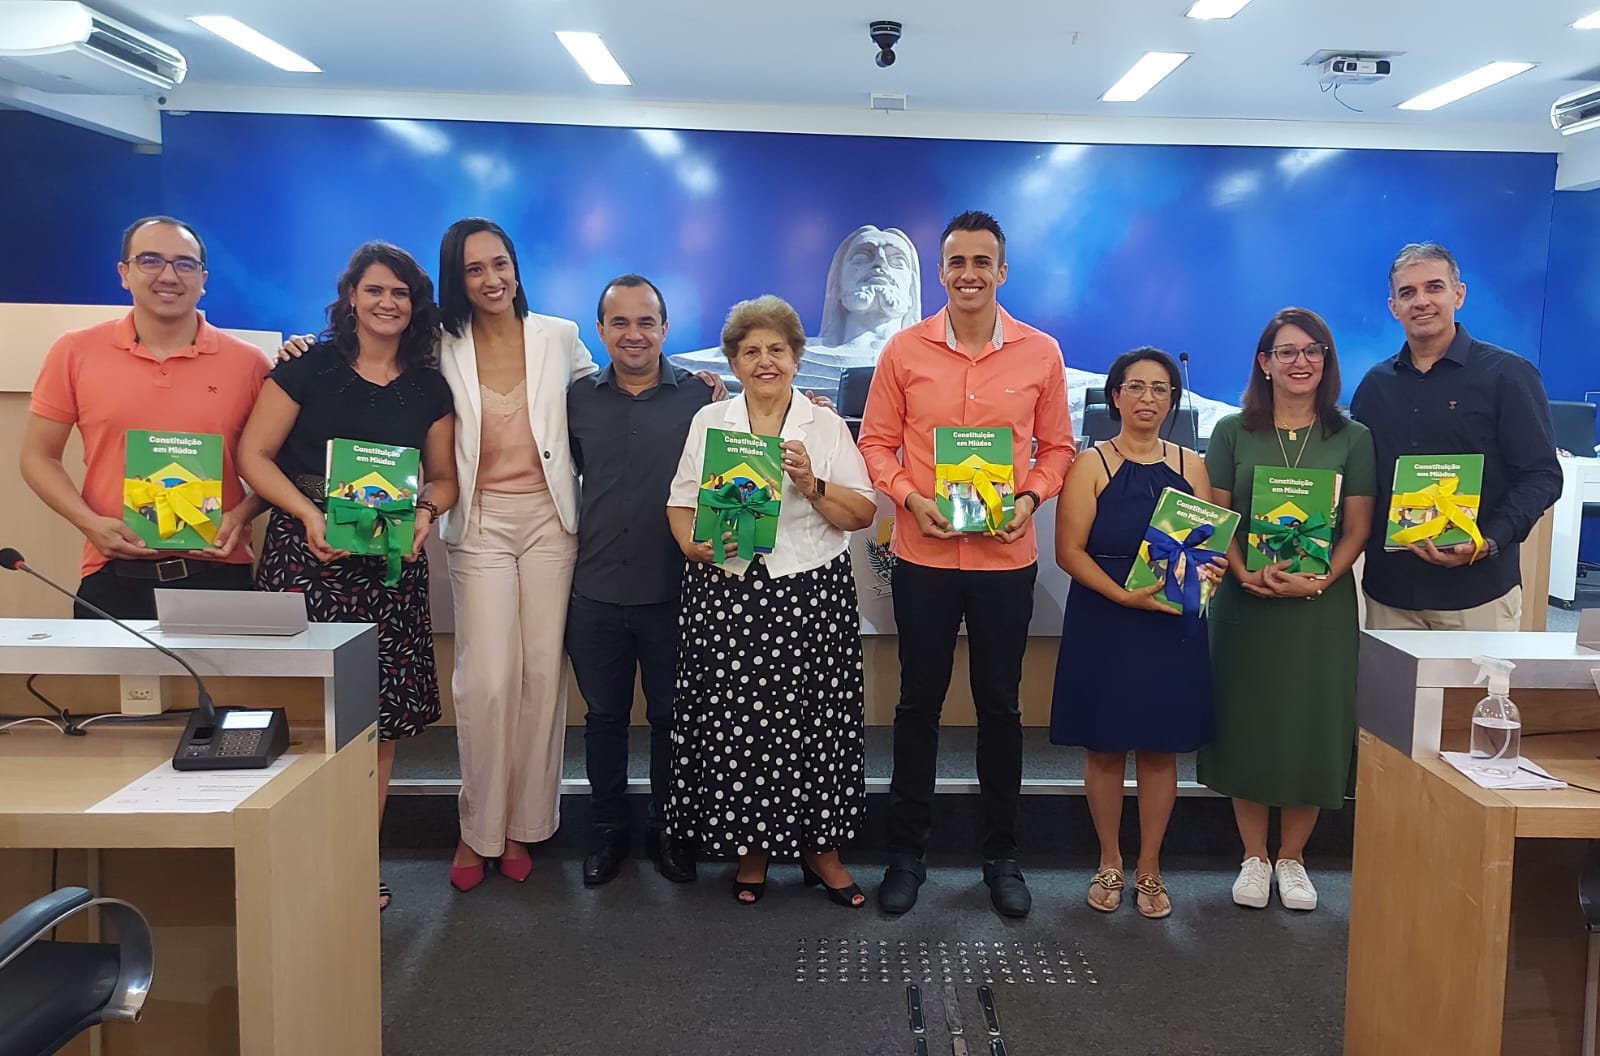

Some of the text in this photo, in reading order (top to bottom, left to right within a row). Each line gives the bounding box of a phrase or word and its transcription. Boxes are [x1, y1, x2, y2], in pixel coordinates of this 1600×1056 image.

[953, 431, 995, 439] Constituição
[149, 436, 202, 446] Constituição
[724, 435, 768, 448] Constituição
[168, 446, 198, 455] Miúdos
[353, 445, 401, 458] Constituição
[739, 447, 764, 456] Miúdos
[370, 456, 396, 466] Miúdos
[1414, 463, 1461, 471] Constituição
[1269, 477, 1314, 487] Constituição
[1284, 487, 1309, 495] Miúdos
[1176, 499, 1219, 519] Constituição
